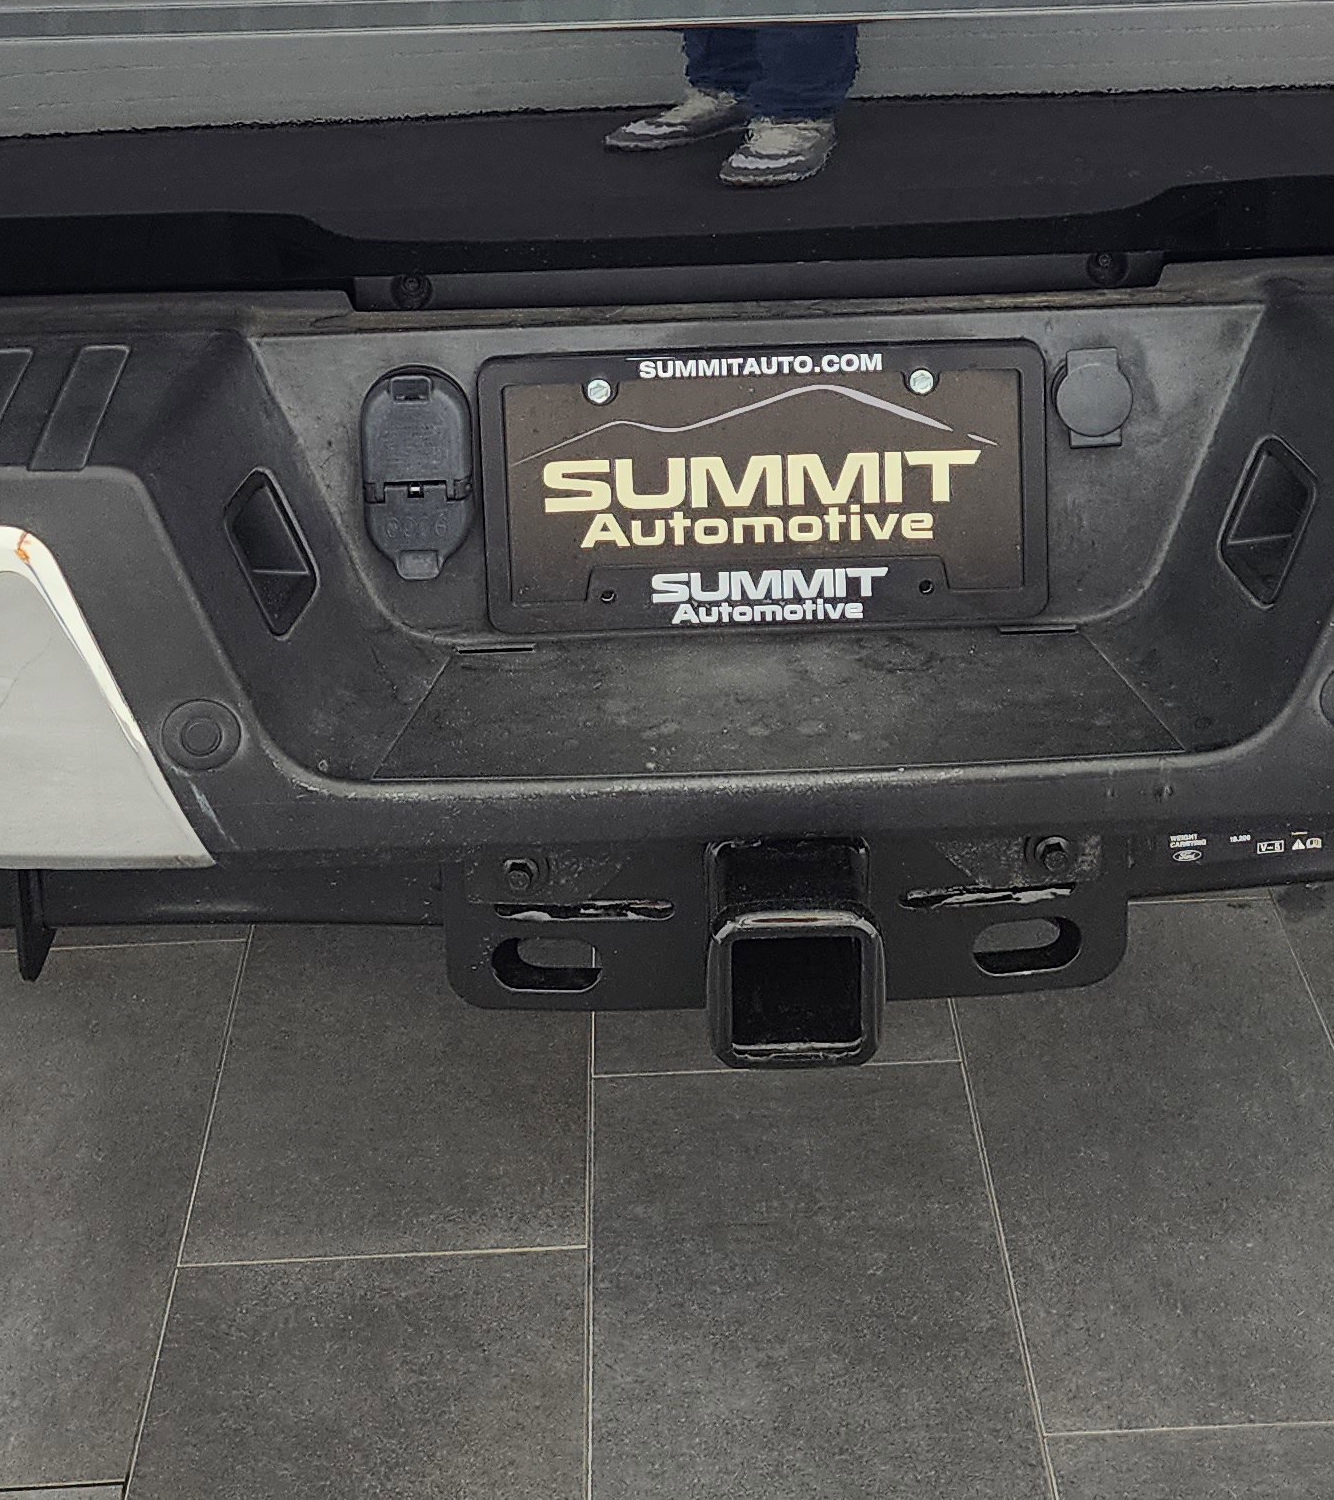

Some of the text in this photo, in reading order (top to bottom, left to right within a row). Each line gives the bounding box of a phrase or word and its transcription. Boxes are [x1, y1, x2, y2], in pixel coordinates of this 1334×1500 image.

[639, 353, 883, 379] SUMMITAUTO.COM
[543, 449, 982, 513] SUMMIT
[580, 504, 934, 549] Automotive
[651, 566, 889, 604] SUMMIT
[671, 599, 864, 625] Automotive
